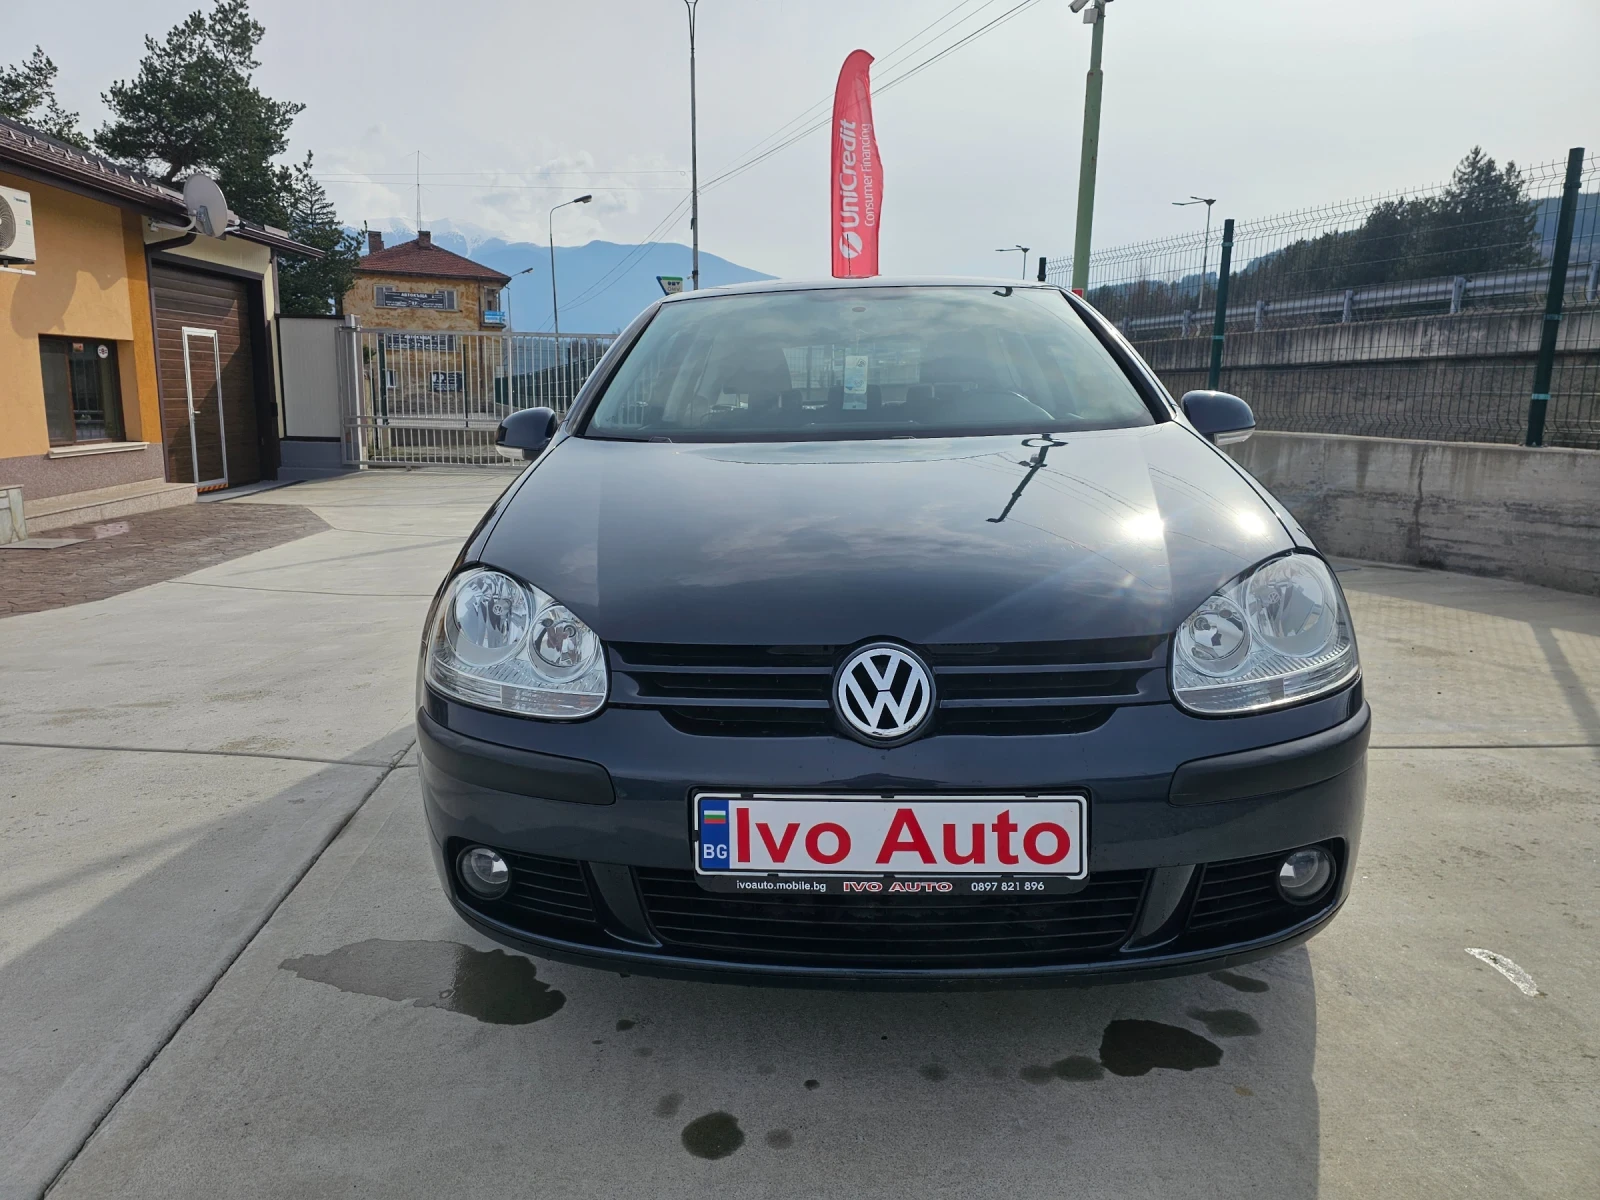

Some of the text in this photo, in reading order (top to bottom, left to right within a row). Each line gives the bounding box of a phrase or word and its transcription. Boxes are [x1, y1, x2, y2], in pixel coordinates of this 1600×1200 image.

[839, 119, 860, 228] UniCredit
[859, 123, 876, 227] Consumer Financing
[838, 648, 930, 738] VW
[703, 843, 728, 859] BG
[736, 807, 1071, 866] Ivo Auto
[736, 880, 827, 892] ivoauto.mobile.bg
[843, 881, 953, 893] IVO AUTO
[971, 881, 1045, 892] 0897 821 896
